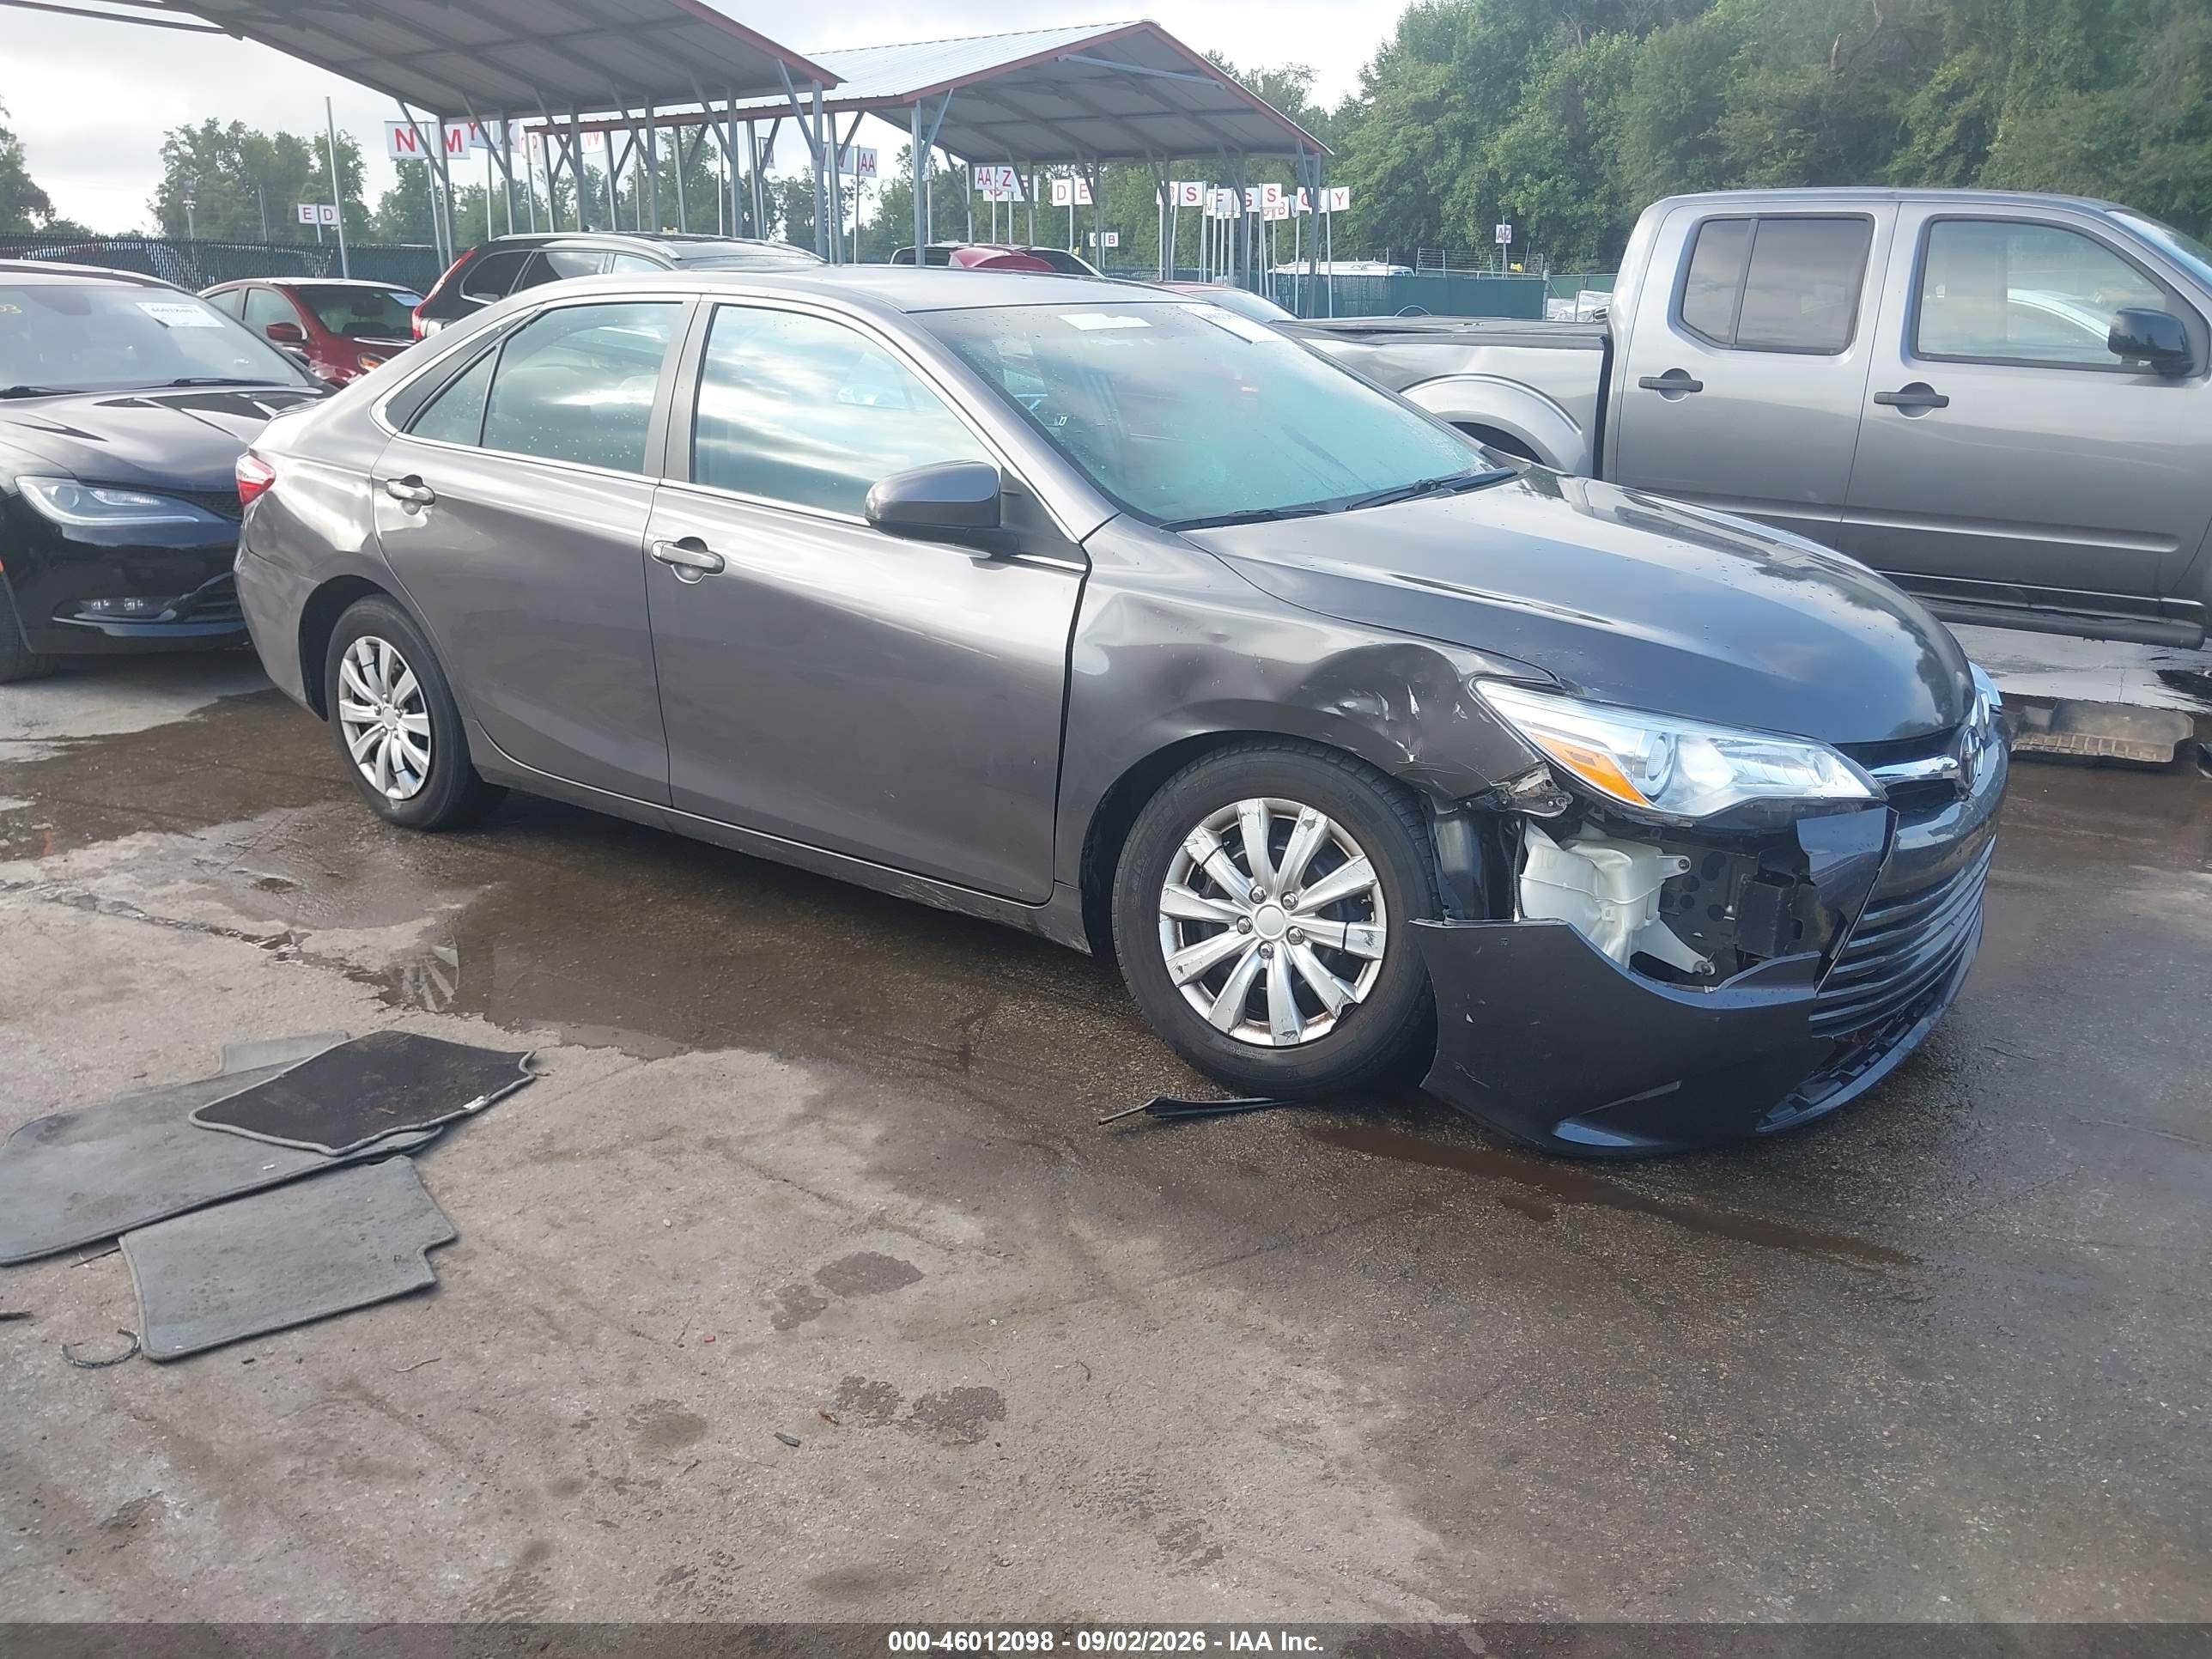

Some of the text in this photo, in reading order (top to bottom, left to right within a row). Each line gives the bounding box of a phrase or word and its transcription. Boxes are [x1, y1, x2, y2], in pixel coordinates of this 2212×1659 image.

[394, 128, 416, 152] N
[860, 152, 876, 171] AA
[977, 167, 1012, 187] AA Z
[1056, 183, 1088, 200] D E
[1186, 186, 1197, 202] S
[1267, 187, 1277, 203] S
[1334, 191, 1345, 206] Y
[302, 207, 333, 221] E D
[1108, 234, 1115, 245] B
